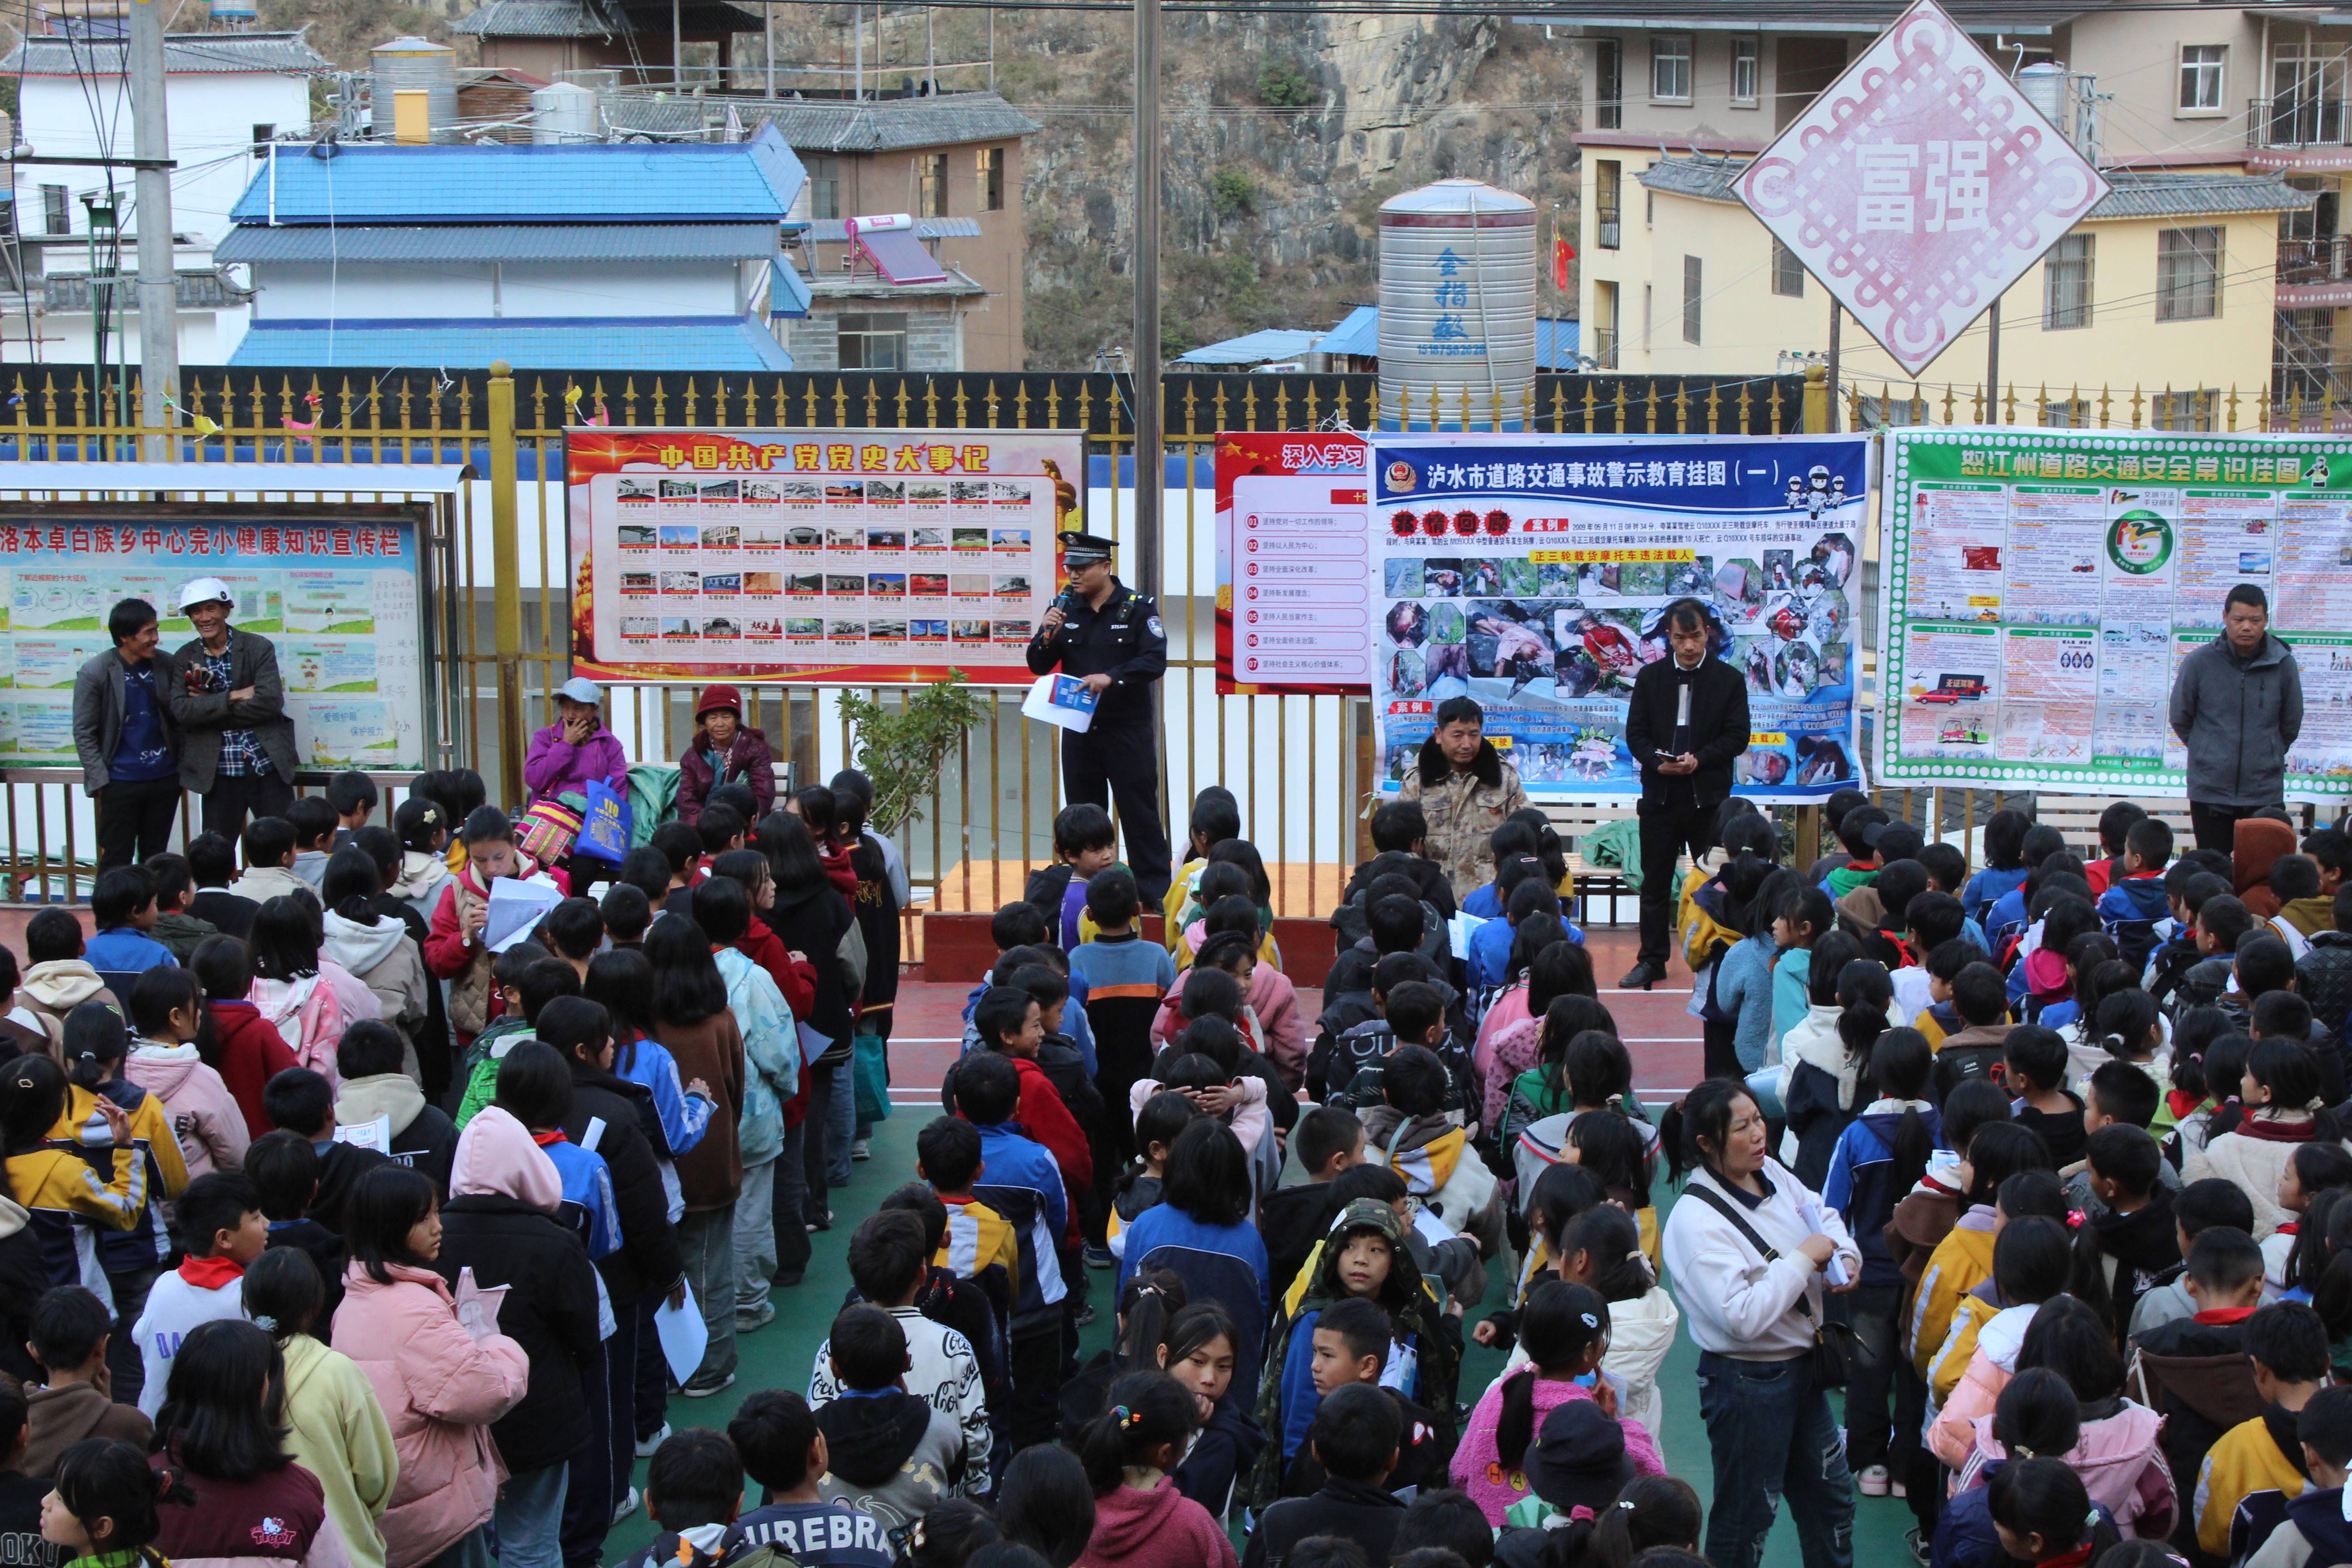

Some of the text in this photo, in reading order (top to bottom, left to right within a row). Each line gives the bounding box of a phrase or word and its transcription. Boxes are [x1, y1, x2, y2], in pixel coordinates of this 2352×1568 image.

[1856, 137, 1991, 234] 富强
[660, 444, 990, 473] 中国共产党党史大事记
[1282, 445, 1366, 469] 深入学习
[1961, 449, 2300, 484] 怒江州道路交通安全常识挂图
[1428, 459, 1779, 490] 泸水市道路交通事故警示教育挂图（一）
[1248, 518, 1258, 526] 01
[1532, 519, 1558, 531] 案例
[0, 524, 401, 557] 洛本卓白族乡中心完小健康知识宣传栏
[1535, 550, 1690, 561] 正三轮载货摩托车违法载人
[1248, 565, 1258, 573] 03
[1248, 613, 1258, 621] 05
[1397, 701, 1423, 713] 案例
[324, 712, 358, 722] 爱眼护眼
[351, 726, 383, 736] 保护视力
[604, 798, 619, 818] 110
